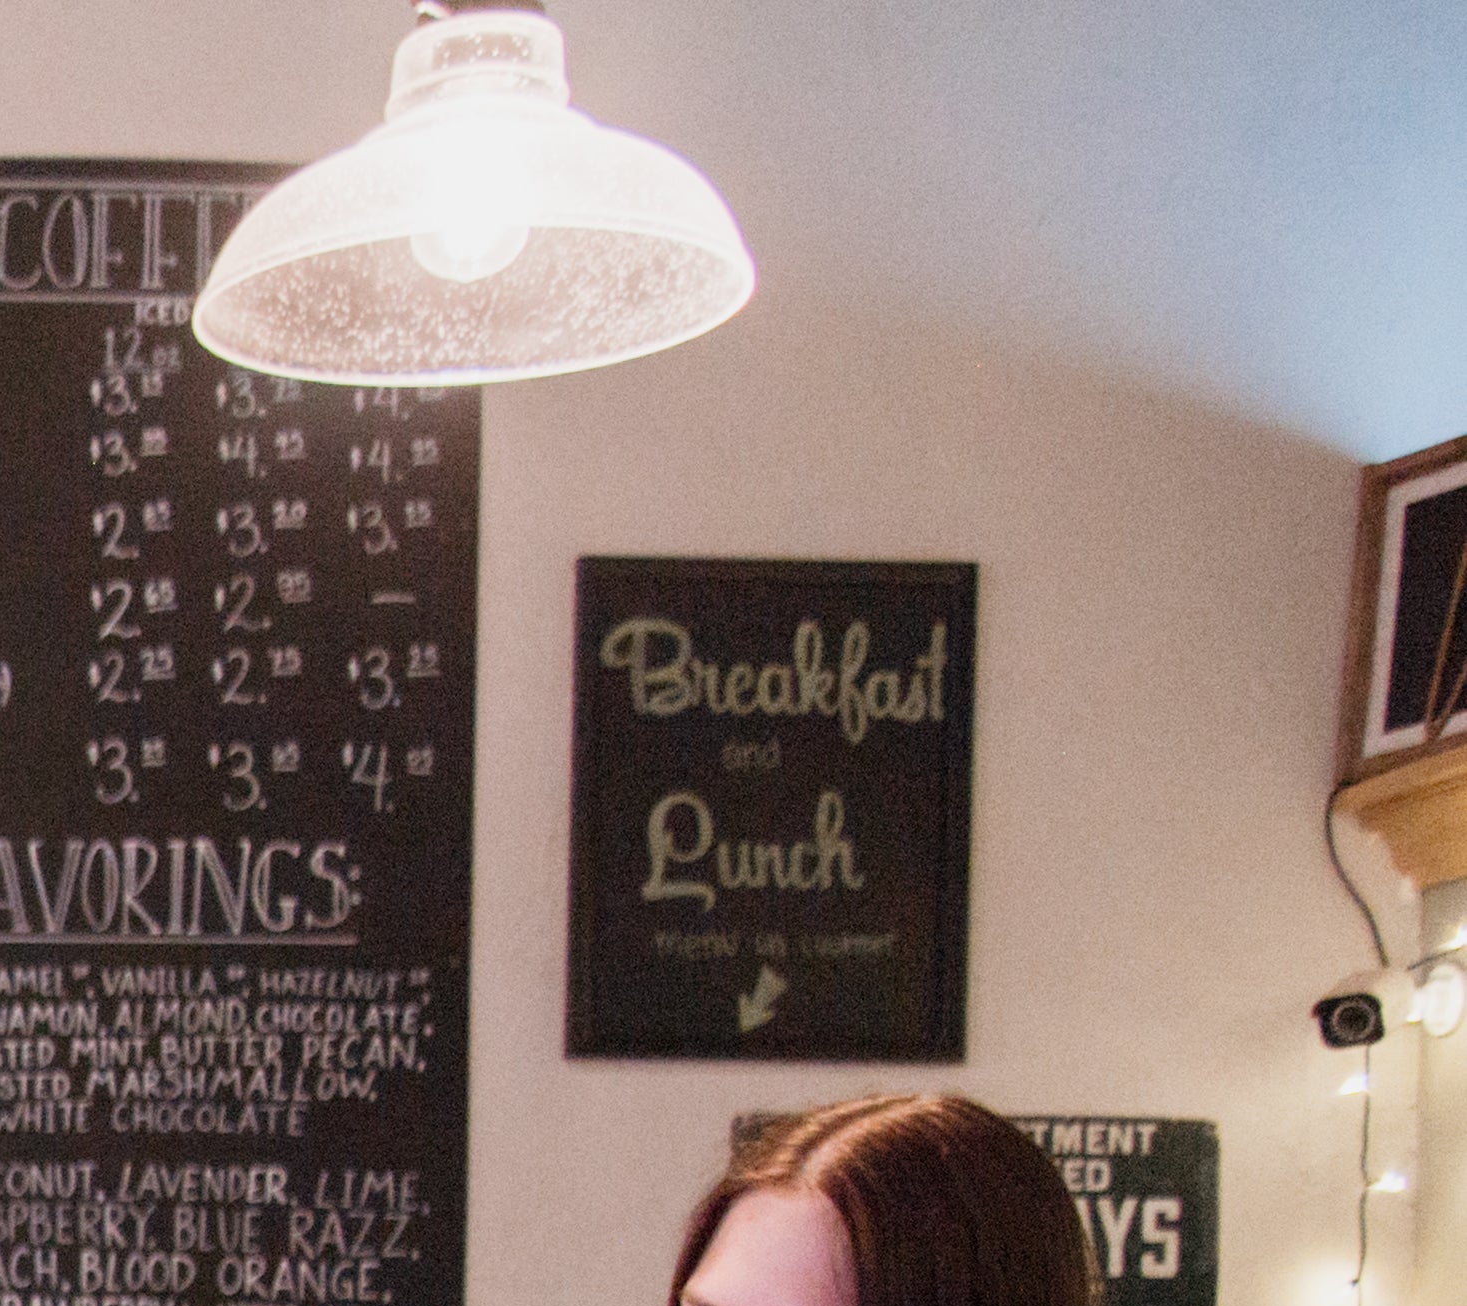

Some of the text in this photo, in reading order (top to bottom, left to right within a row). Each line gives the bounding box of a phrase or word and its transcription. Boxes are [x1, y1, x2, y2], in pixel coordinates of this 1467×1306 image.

[600, 617, 948, 746] Breakfast
[642, 792, 864, 912] Lunch
[161, 1036, 283, 1068] BUTTER
[111, 1100, 304, 1136] CHOCOLATE
[174, 1206, 263, 1252] BLUE
[81, 1250, 196, 1293] BLOOD
